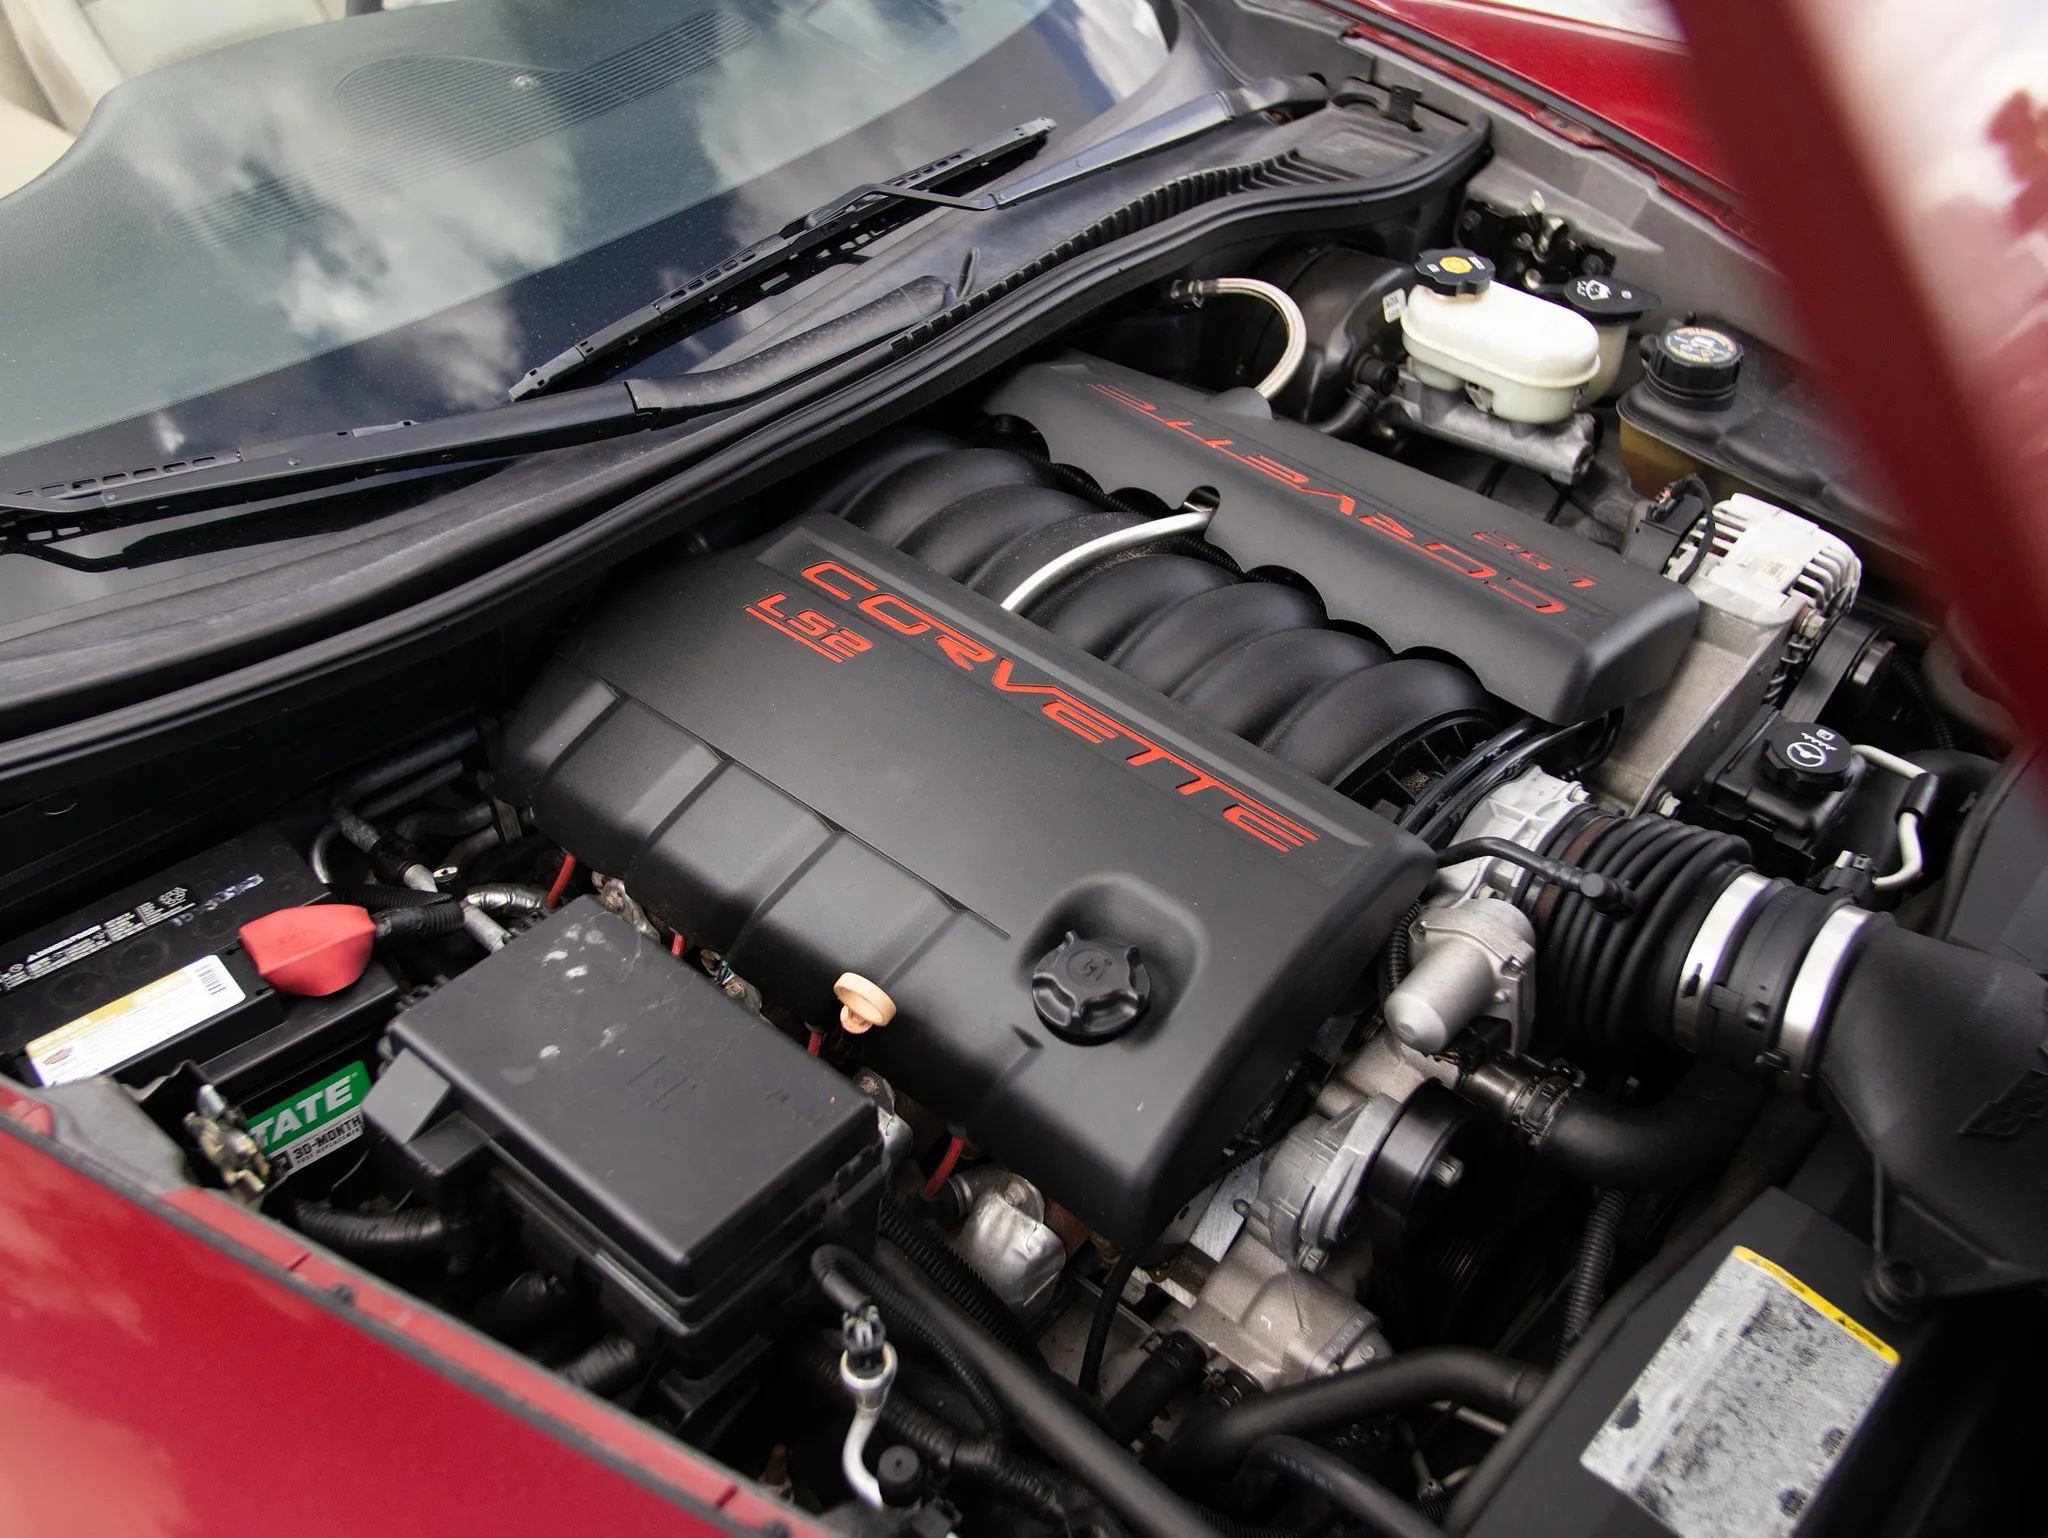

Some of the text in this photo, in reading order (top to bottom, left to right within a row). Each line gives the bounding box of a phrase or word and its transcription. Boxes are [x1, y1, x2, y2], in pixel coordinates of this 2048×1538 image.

[1086, 383, 1567, 613] CORVETTE
[754, 591, 874, 659] LS2
[800, 560, 1320, 854] CORVETTE
